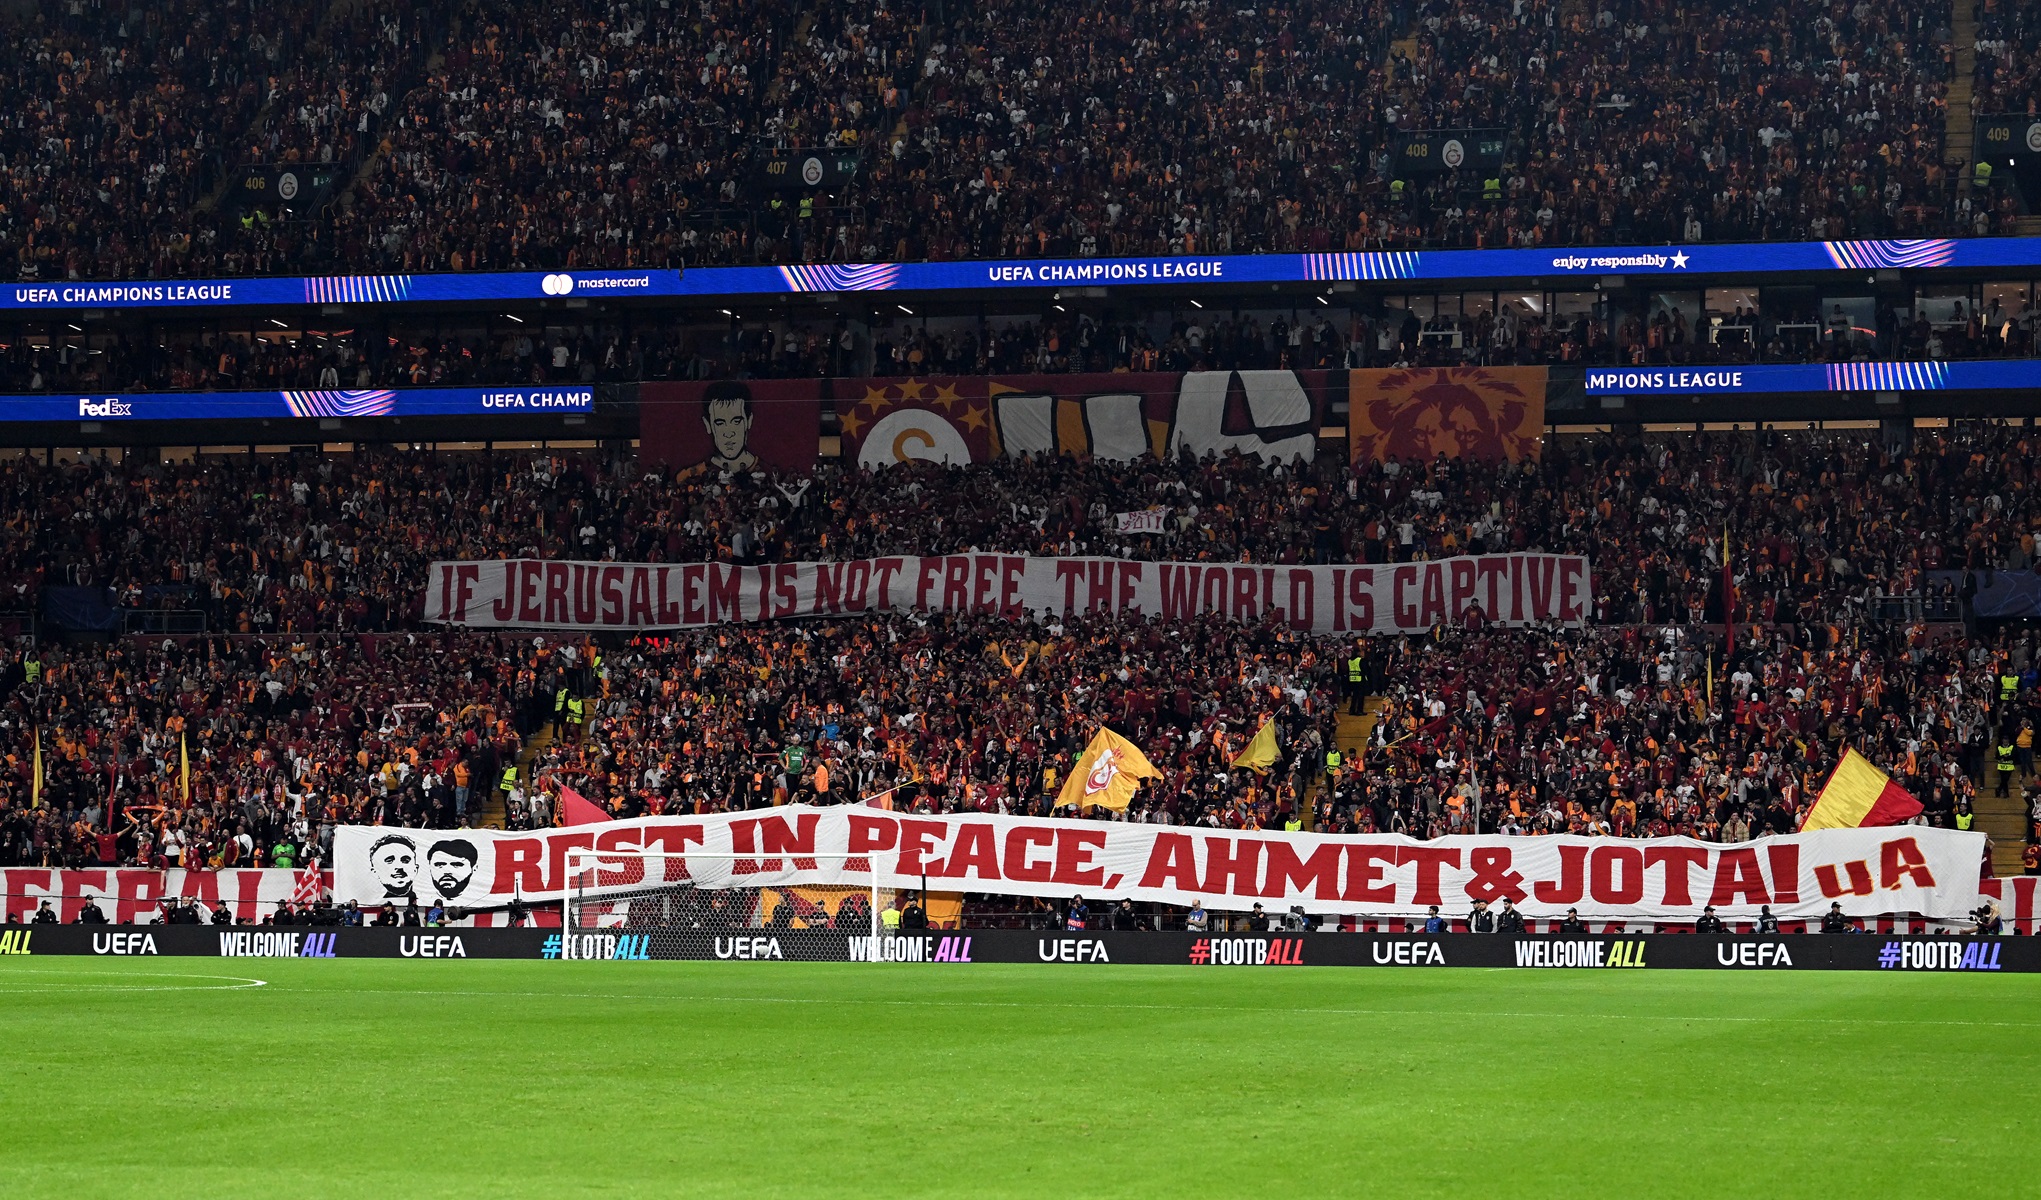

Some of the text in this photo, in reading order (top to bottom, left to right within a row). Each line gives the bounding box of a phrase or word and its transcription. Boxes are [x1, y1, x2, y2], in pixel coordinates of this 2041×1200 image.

[1986, 127, 2010, 141] 409
[1406, 143, 1428, 157] 408
[766, 161, 787, 175] 407
[245, 176, 266, 190] 406
[989, 261, 1223, 281] UEFA CHAMPIONS LEAGUE
[1552, 254, 1668, 270] enjoy responsibly
[16, 285, 232, 303] UEFA CHAMPIONS LEAGUE
[578, 276, 649, 289] mastercard
[1669, 372, 1743, 388] LEAGUE
[79, 398, 132, 416] FedEx
[482, 392, 592, 408] UEFA CHAMP
[438, 555, 1583, 632] IF JERUSALEM IS NOT FREE THE WORLD IS CAPTIVE
[489, 823, 704, 895] REST
[729, 813, 821, 876] IN
[842, 813, 1125, 890] PEACE,
[1533, 843, 1800, 907] JOTA!
[0, 930, 31, 955] ALL
[93, 932, 158, 955] UEFA
[219, 931, 337, 958] WELCOME ALL
[400, 935, 466, 958] UEFA
[541, 934, 650, 960] #FOOTBALL
[714, 936, 783, 959] UEFA
[849, 936, 972, 963] WELCOME ALL
[1039, 939, 1110, 962] UEFA
[1189, 938, 1304, 965] #FOOTBALL
[1372, 941, 1446, 965] UEFA
[1515, 940, 1646, 968] WELCOME ALL
[1717, 943, 1793, 966] UEFA
[1878, 941, 2002, 970] #FOOTBALL
